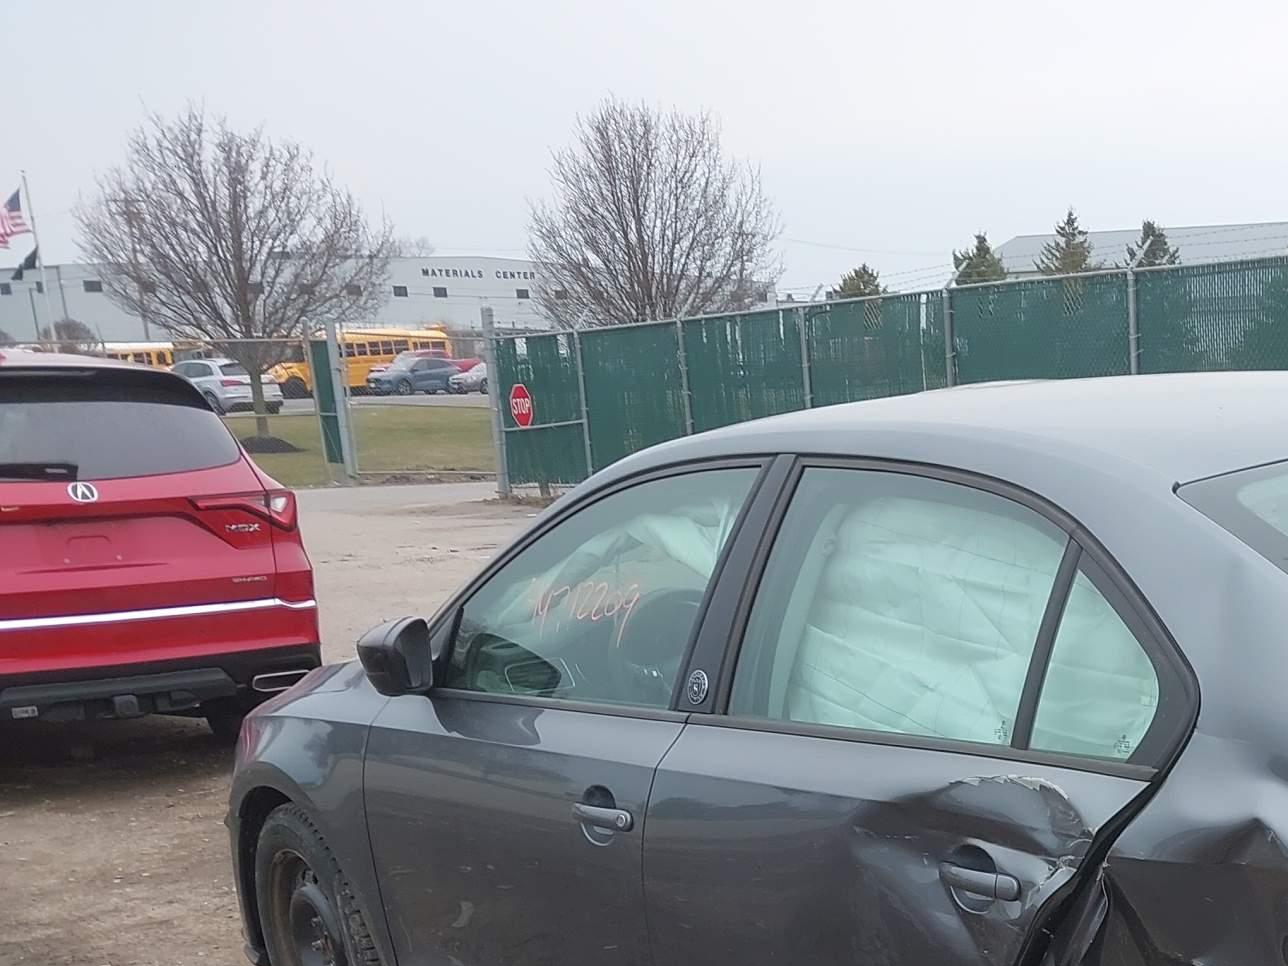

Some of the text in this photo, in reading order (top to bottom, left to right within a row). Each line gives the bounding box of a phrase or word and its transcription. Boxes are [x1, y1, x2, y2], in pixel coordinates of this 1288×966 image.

[421, 268, 536, 280] MATERIALS CENTER
[512, 398, 530, 415] STOP
